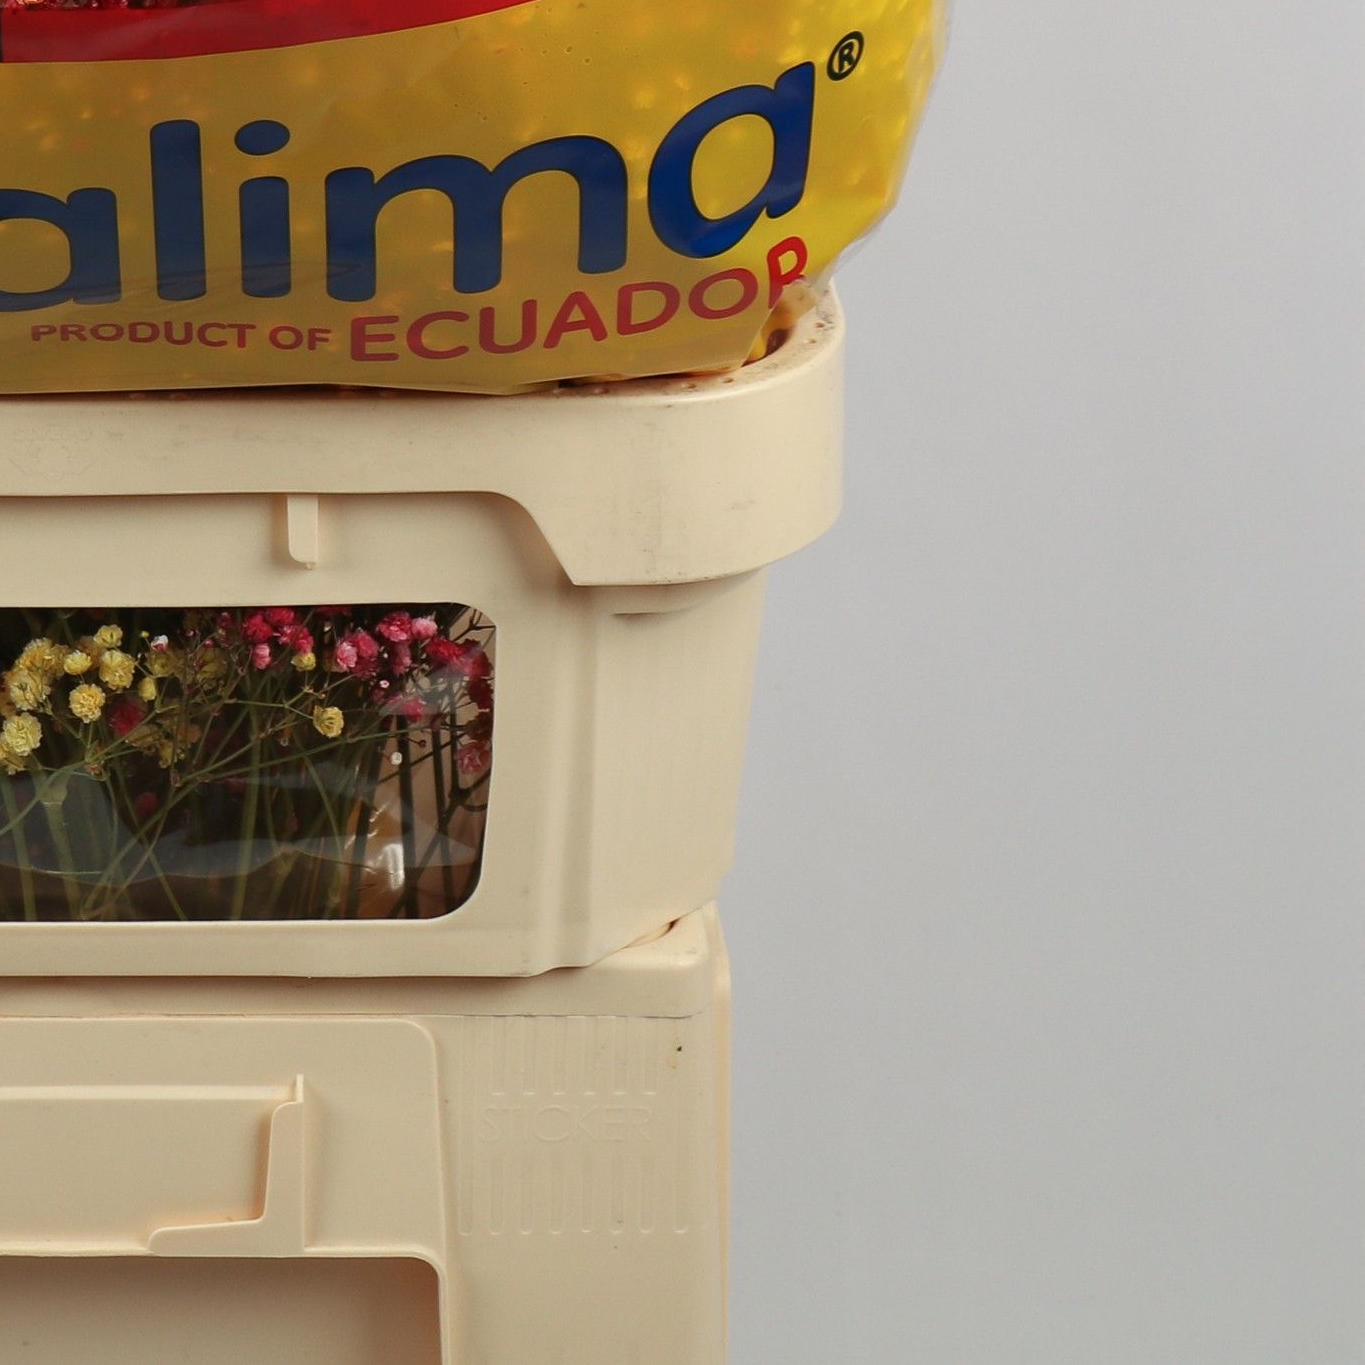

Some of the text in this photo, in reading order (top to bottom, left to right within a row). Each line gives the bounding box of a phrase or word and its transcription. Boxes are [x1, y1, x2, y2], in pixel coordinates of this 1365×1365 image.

[31, 236, 808, 362] PRODUCT OF ECUADOR
[478, 1104, 652, 1143] STICKER
